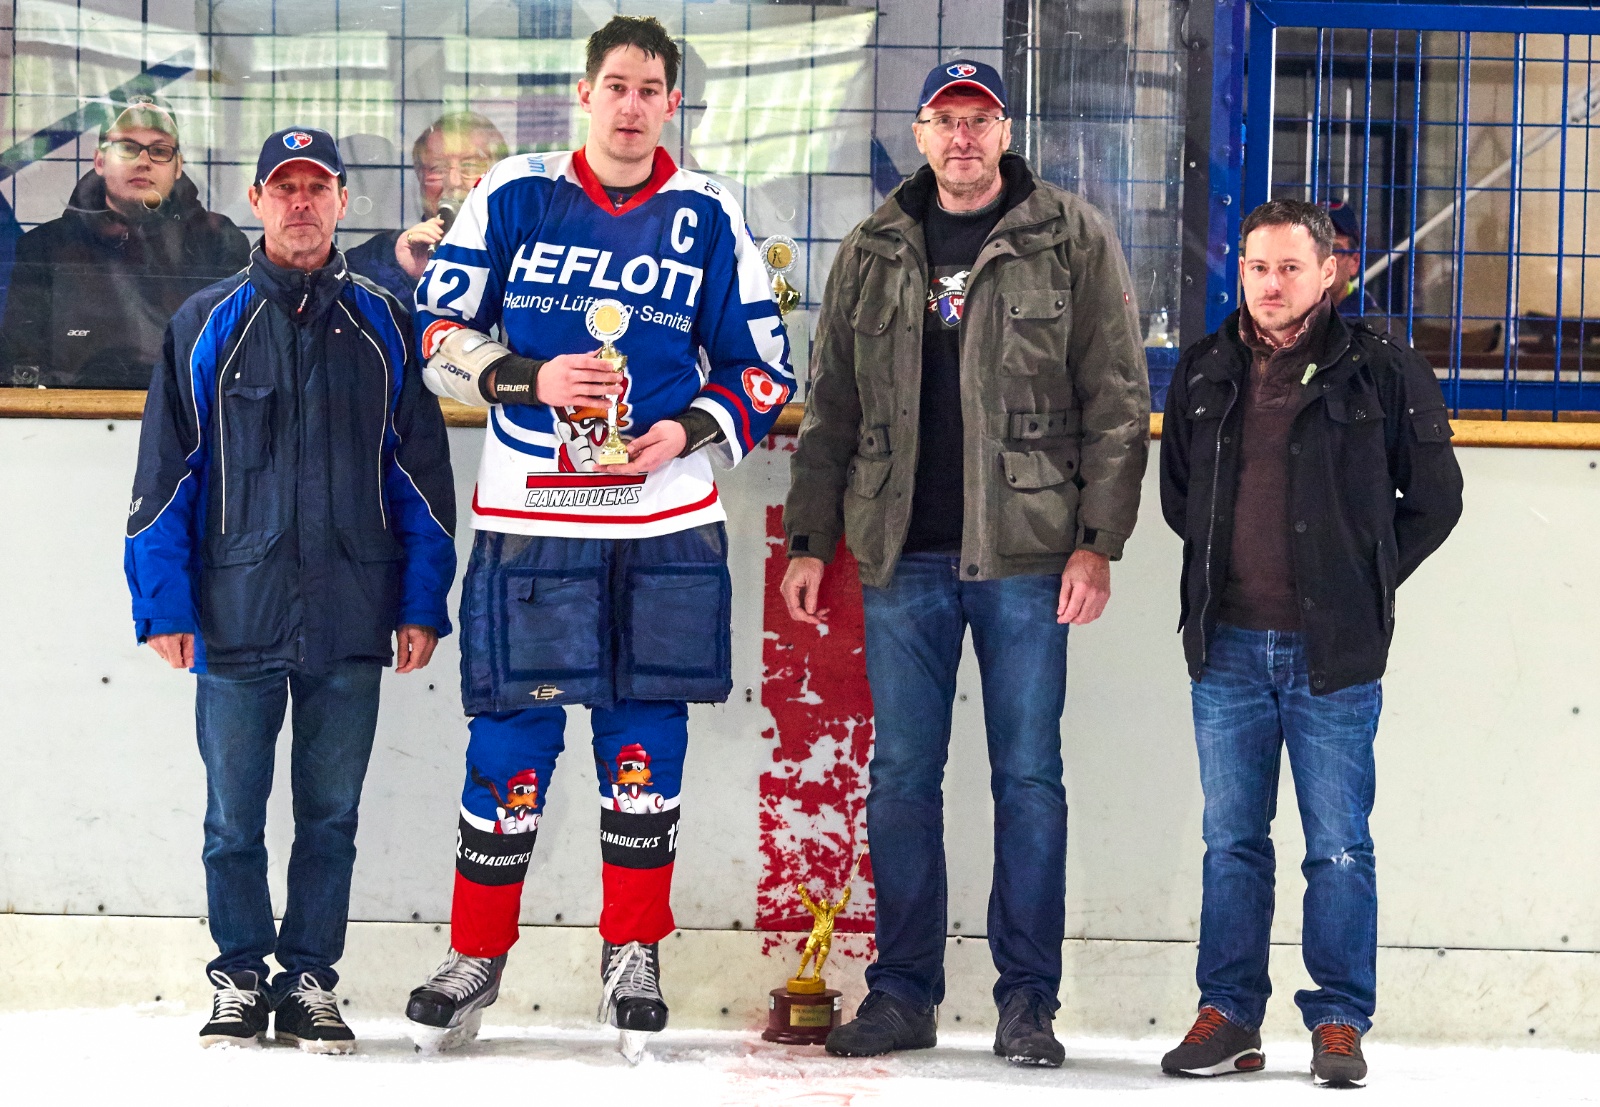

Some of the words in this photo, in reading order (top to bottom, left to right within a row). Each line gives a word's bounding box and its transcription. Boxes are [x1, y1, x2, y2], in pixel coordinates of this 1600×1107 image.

[671, 207, 698, 254] C
[67, 329, 91, 337] acer
[440, 362, 473, 382] JOFA
[525, 486, 642, 507] CANADUCKS
[464, 847, 532, 867] CANADUCKS
